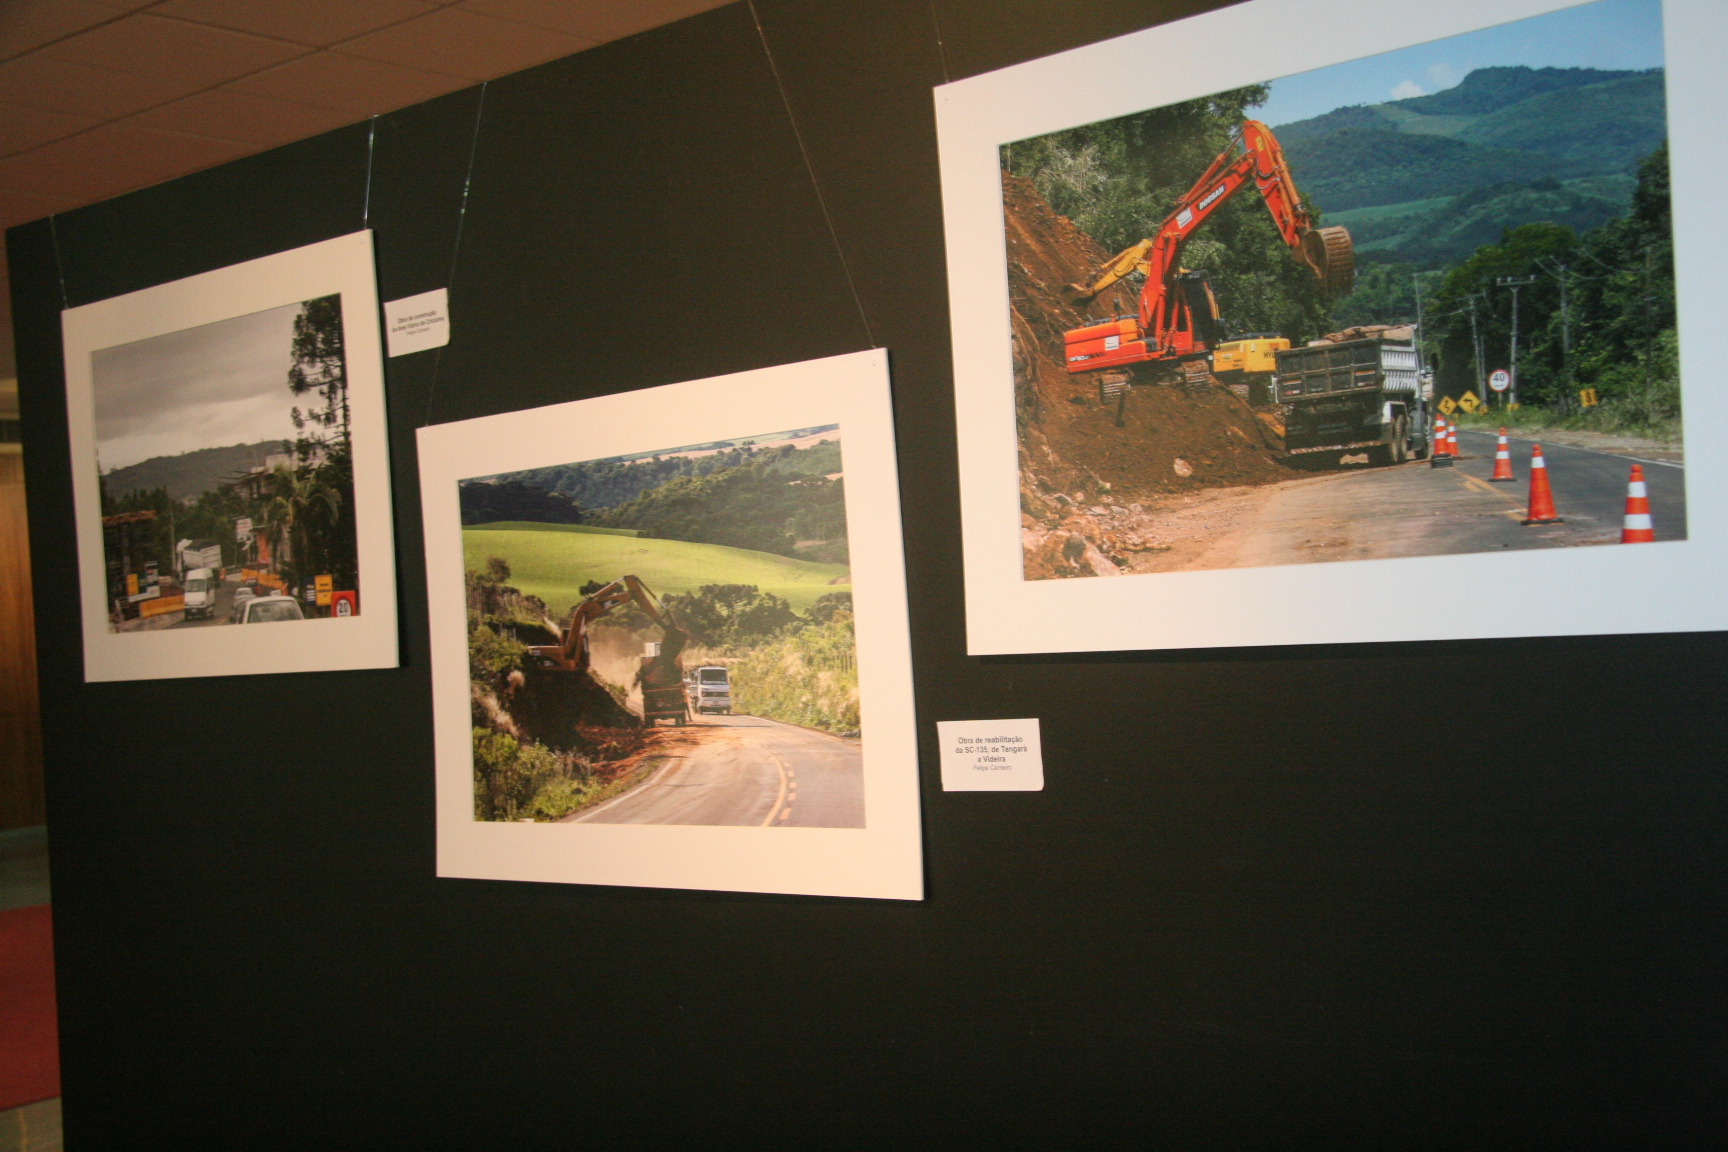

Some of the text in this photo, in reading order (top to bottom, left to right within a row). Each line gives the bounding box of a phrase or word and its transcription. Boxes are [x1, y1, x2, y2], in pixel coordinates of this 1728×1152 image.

[1199, 184, 1225, 210] DOOSAN
[1493, 372, 1505, 381] 40
[338, 602, 349, 613] 20
[985, 735, 1023, 744] reabilitação
[1001, 744, 1027, 754] Tangará
